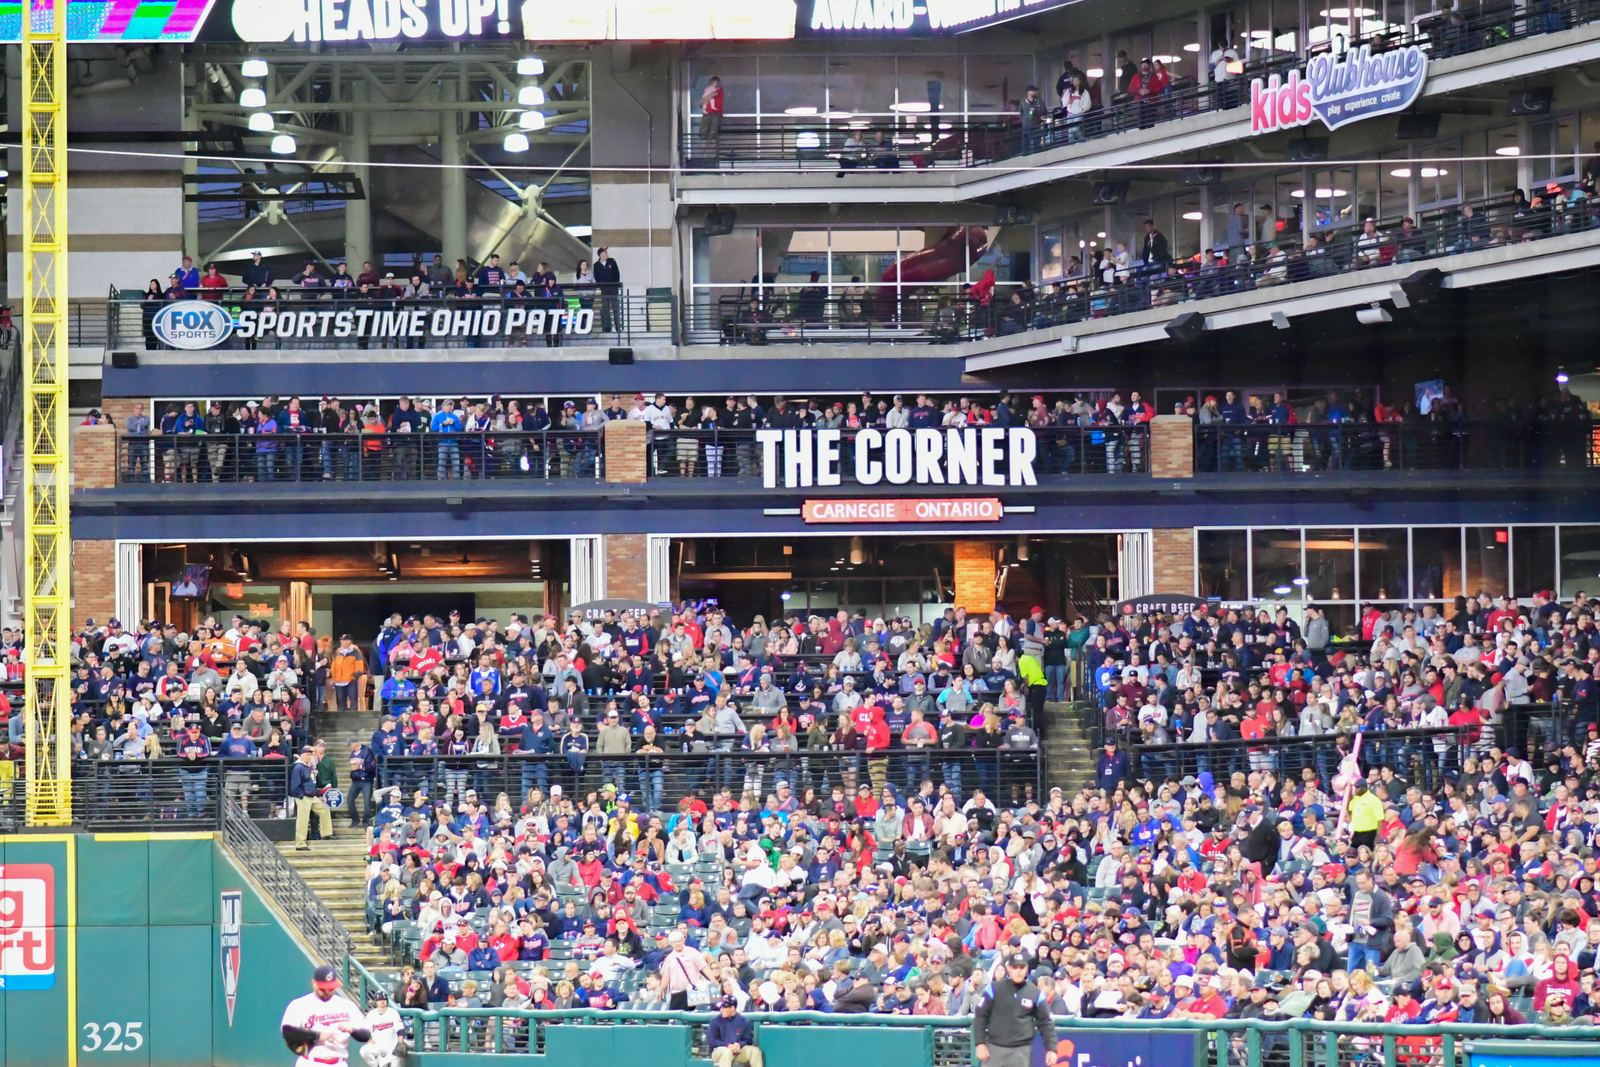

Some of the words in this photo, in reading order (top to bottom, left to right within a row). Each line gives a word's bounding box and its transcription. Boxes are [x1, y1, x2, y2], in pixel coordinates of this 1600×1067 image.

[294, 0, 428, 42] HEADS
[440, 0, 510, 37] UP!
[1252, 71, 1312, 131] kids
[1308, 47, 1420, 99] Clubhouse
[1328, 104, 1341, 116] play
[1345, 96, 1377, 112] experience
[1381, 91, 1401, 103] create
[170, 311, 214, 330] FOX
[171, 330, 216, 339] SPORTS
[430, 309, 501, 337] OHIO
[505, 308, 594, 335] PATIO
[756, 429, 841, 488] THE
[855, 428, 1038, 486] CORNER
[812, 502, 895, 519] CARNEGIE
[915, 501, 993, 517] ONTARIO
[82, 1021, 144, 1052] 325
